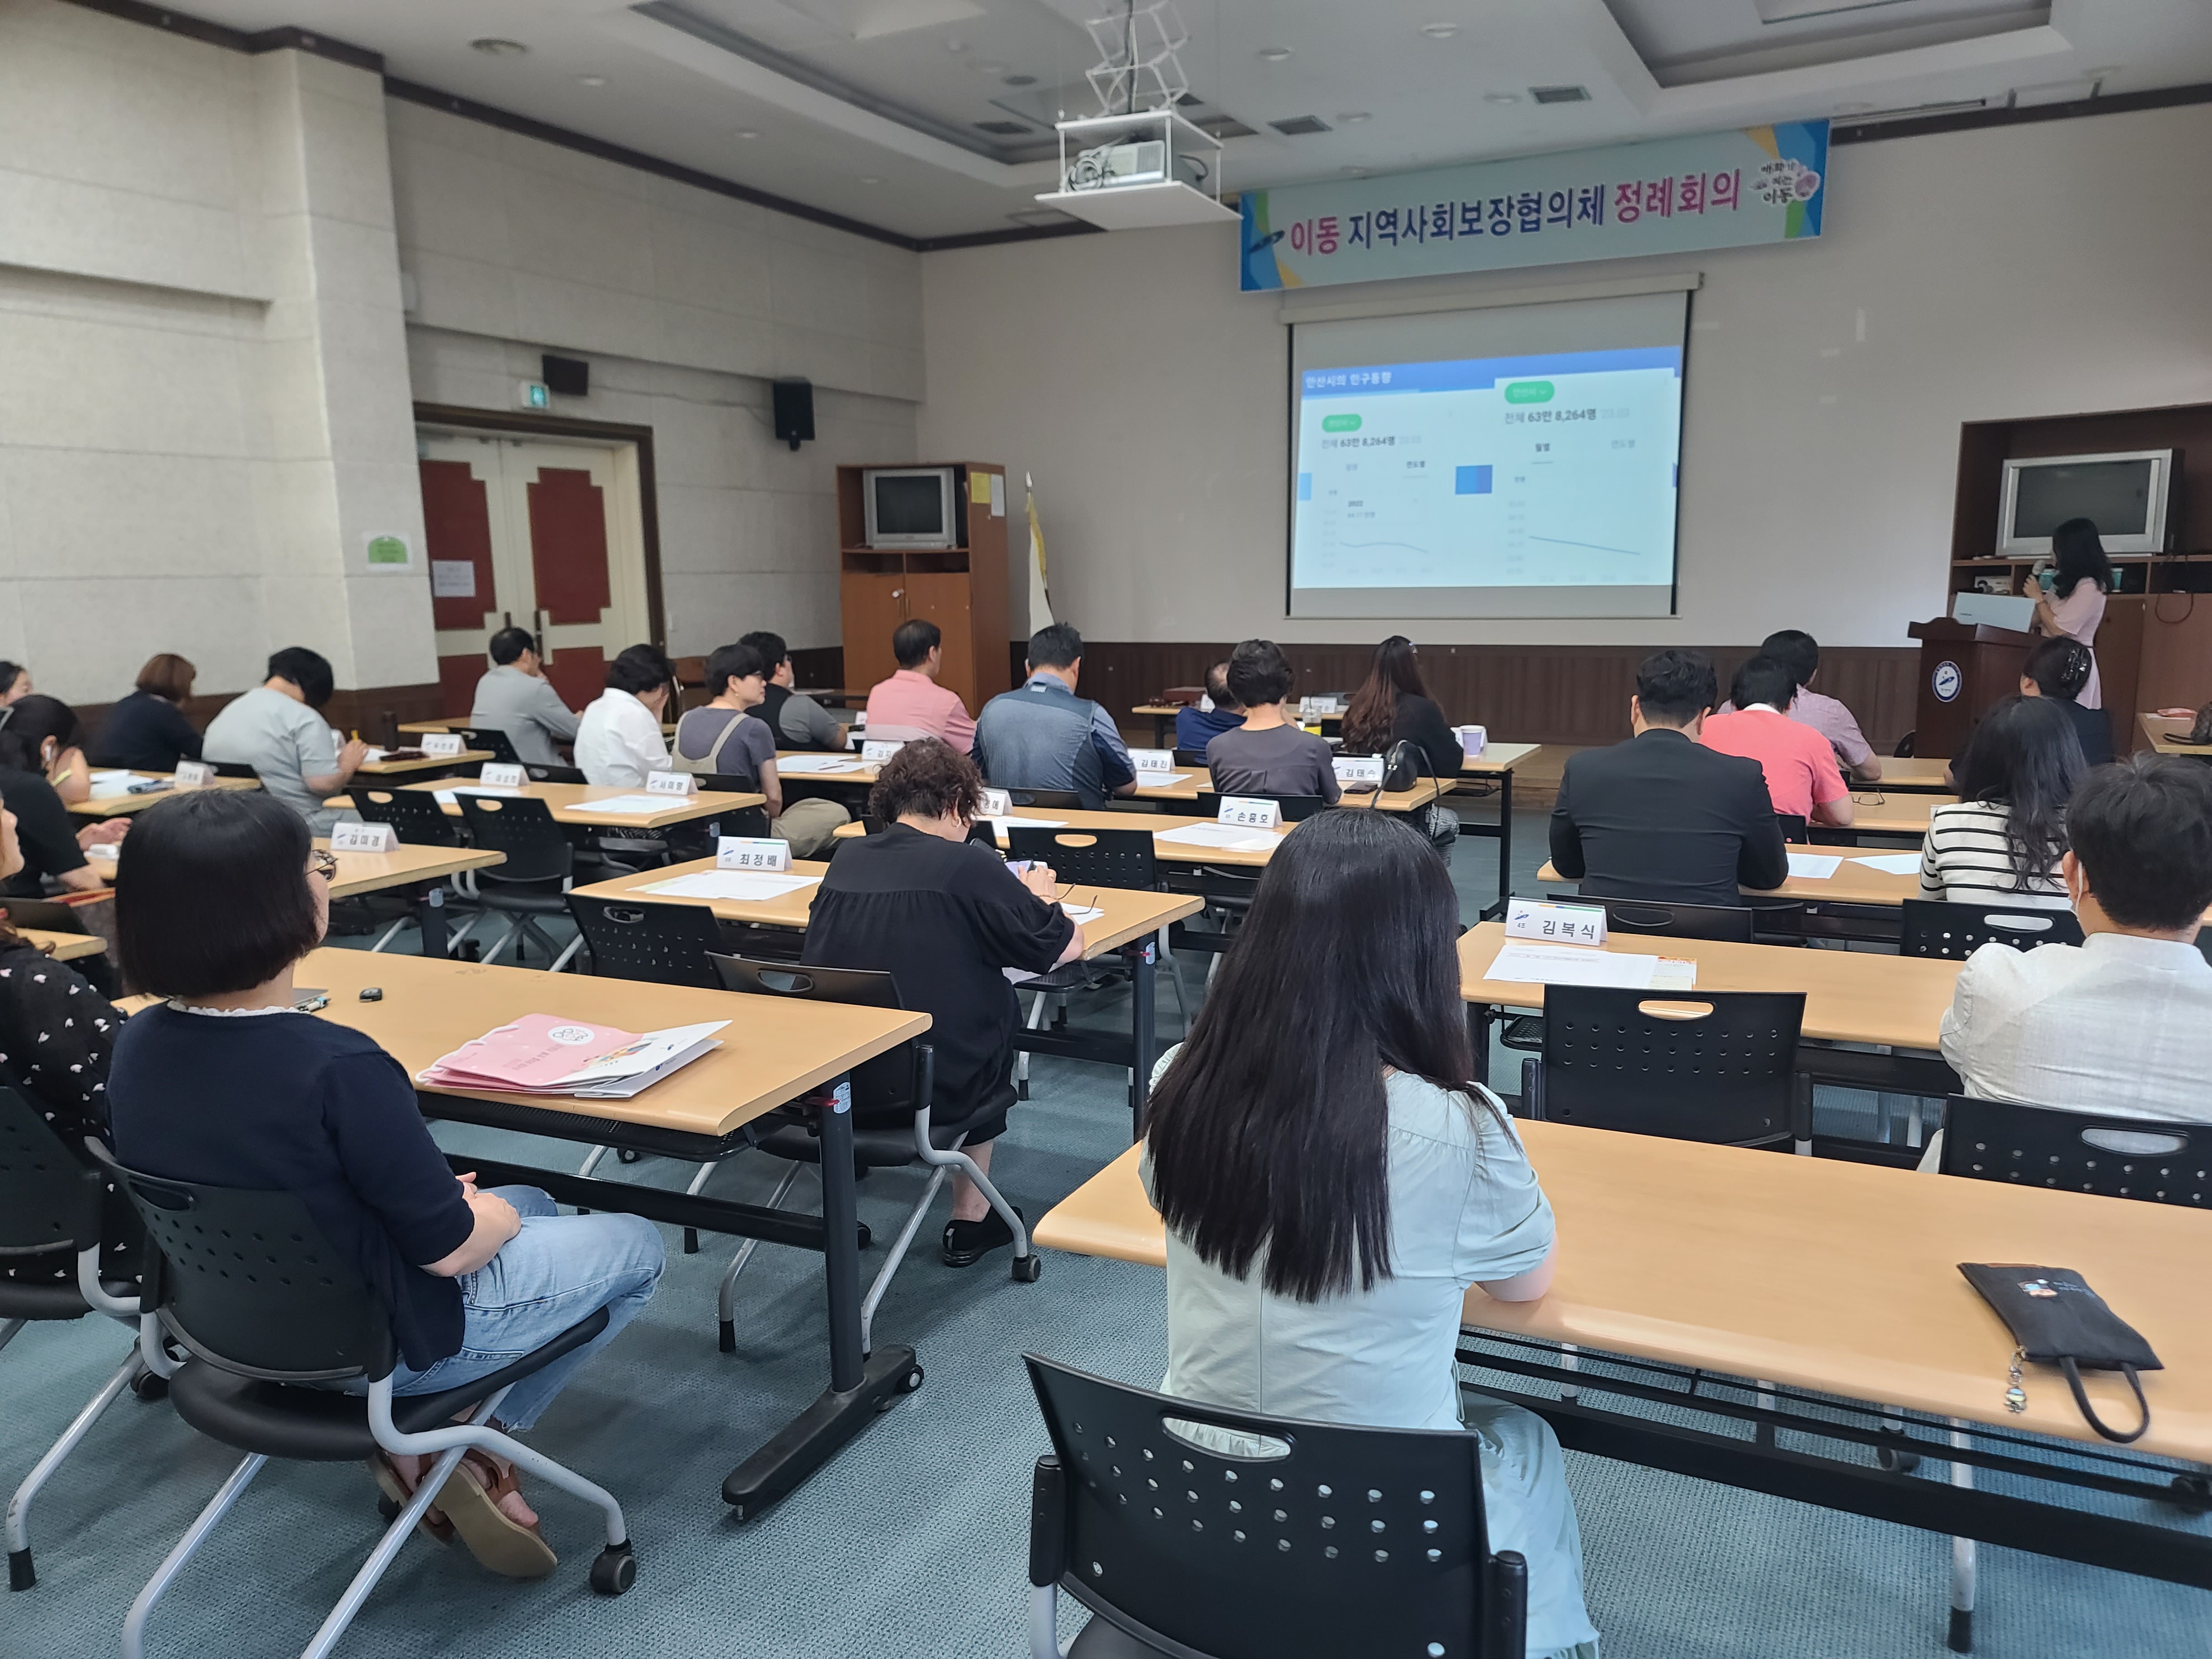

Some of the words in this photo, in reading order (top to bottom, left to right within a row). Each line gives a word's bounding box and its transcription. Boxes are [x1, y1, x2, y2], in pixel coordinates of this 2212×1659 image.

[1291, 216, 1340, 255] 이동
[1348, 184, 1605, 249] 지역사회보장협의체
[1614, 169, 1740, 223] 정례회의
[1528, 410, 1552, 422] 63만
[1555, 408, 1597, 422] 8,264명
[1362, 435, 1395, 447] 8,264명
[739, 853, 777, 867] 최정배
[1542, 920, 1595, 940] 김복식
